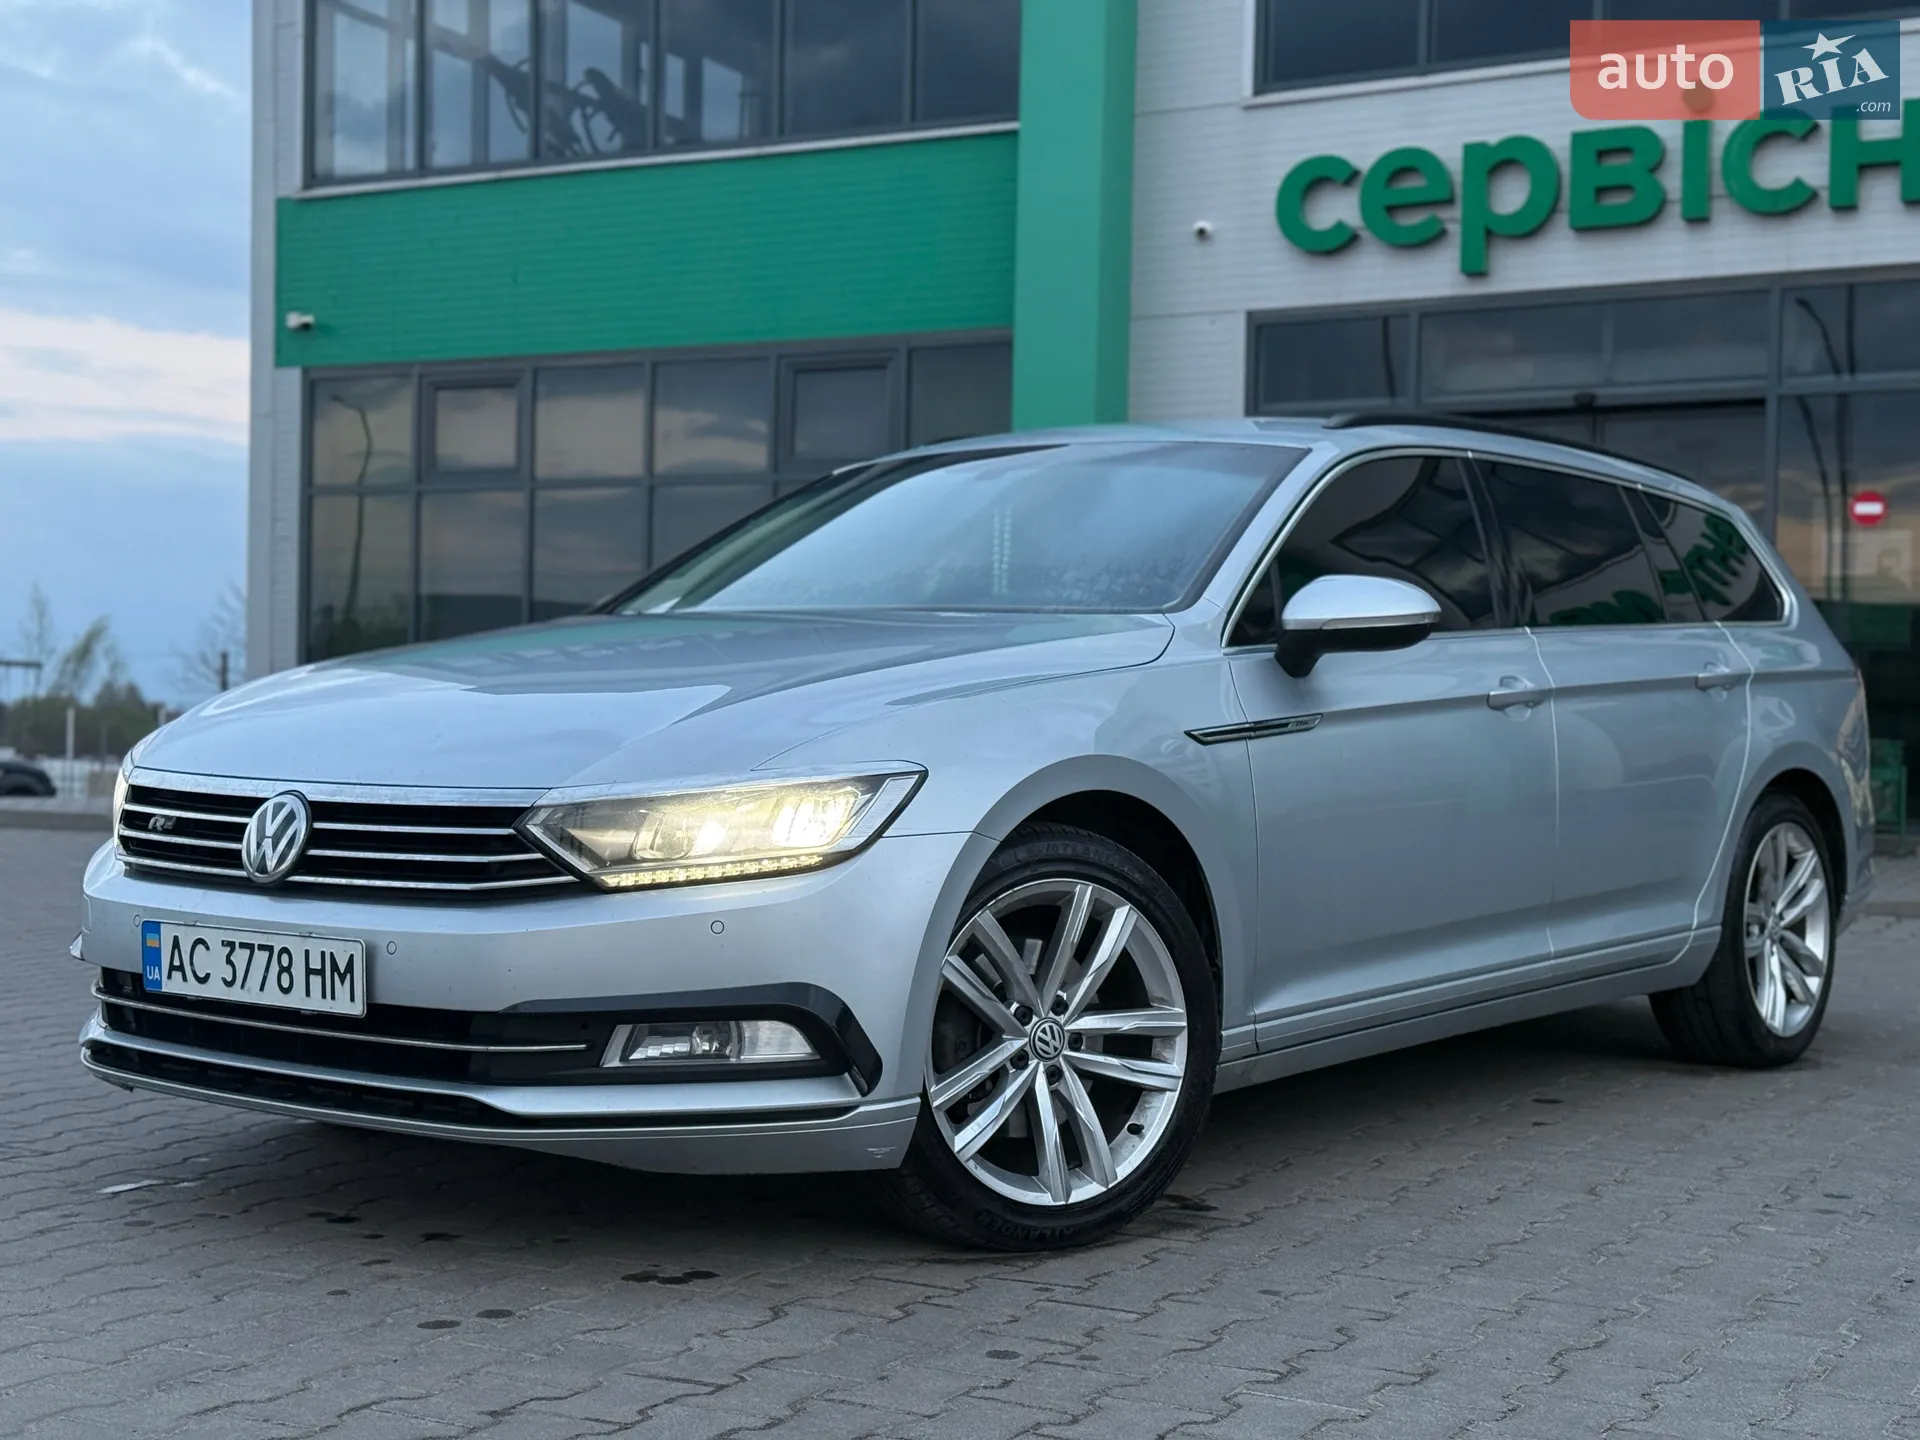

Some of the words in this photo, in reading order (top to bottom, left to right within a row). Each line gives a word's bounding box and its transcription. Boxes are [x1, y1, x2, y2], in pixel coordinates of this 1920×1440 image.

[146, 965, 161, 981] UA
[167, 935, 211, 985] AC
[221, 940, 294, 995] 3778
[304, 949, 355, 1002] HM
